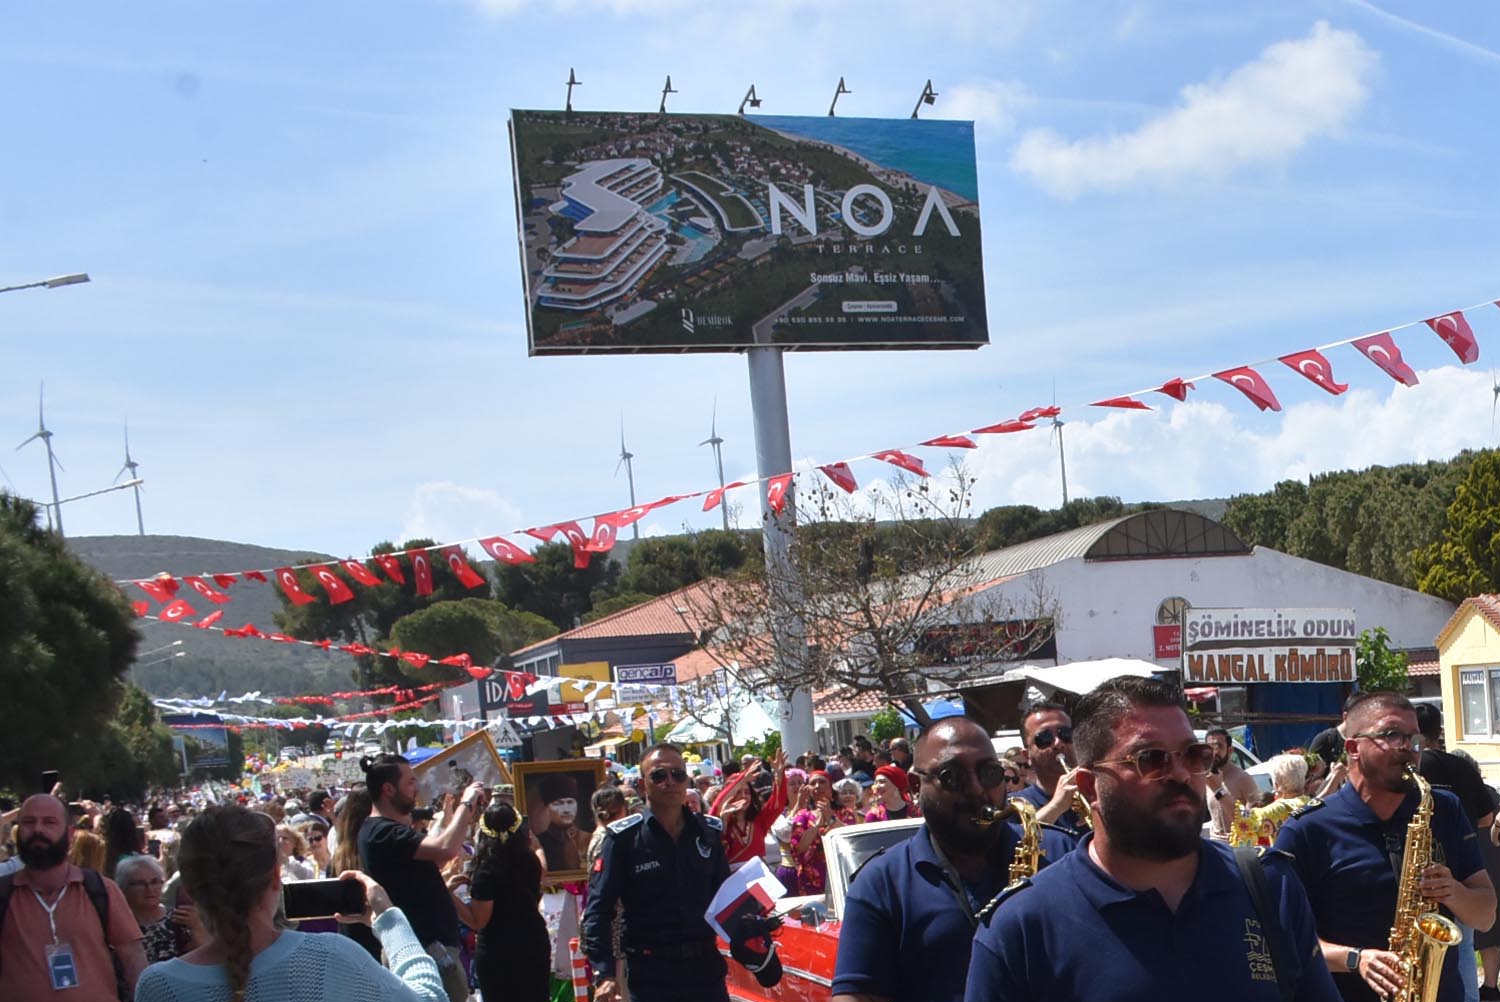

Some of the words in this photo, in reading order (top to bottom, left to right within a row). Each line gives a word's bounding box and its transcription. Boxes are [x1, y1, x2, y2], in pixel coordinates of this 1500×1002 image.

[817, 243, 924, 255] TERRACE
[810, 272, 842, 283] Sonsuz
[1188, 613, 1297, 642] ŞÖMİNELİK
[1303, 618, 1355, 638] ODUN
[1188, 653, 1270, 682] MANGAL
[1274, 648, 1353, 682] KÖMÜRÜ
[635, 860, 661, 873] ZABITA
